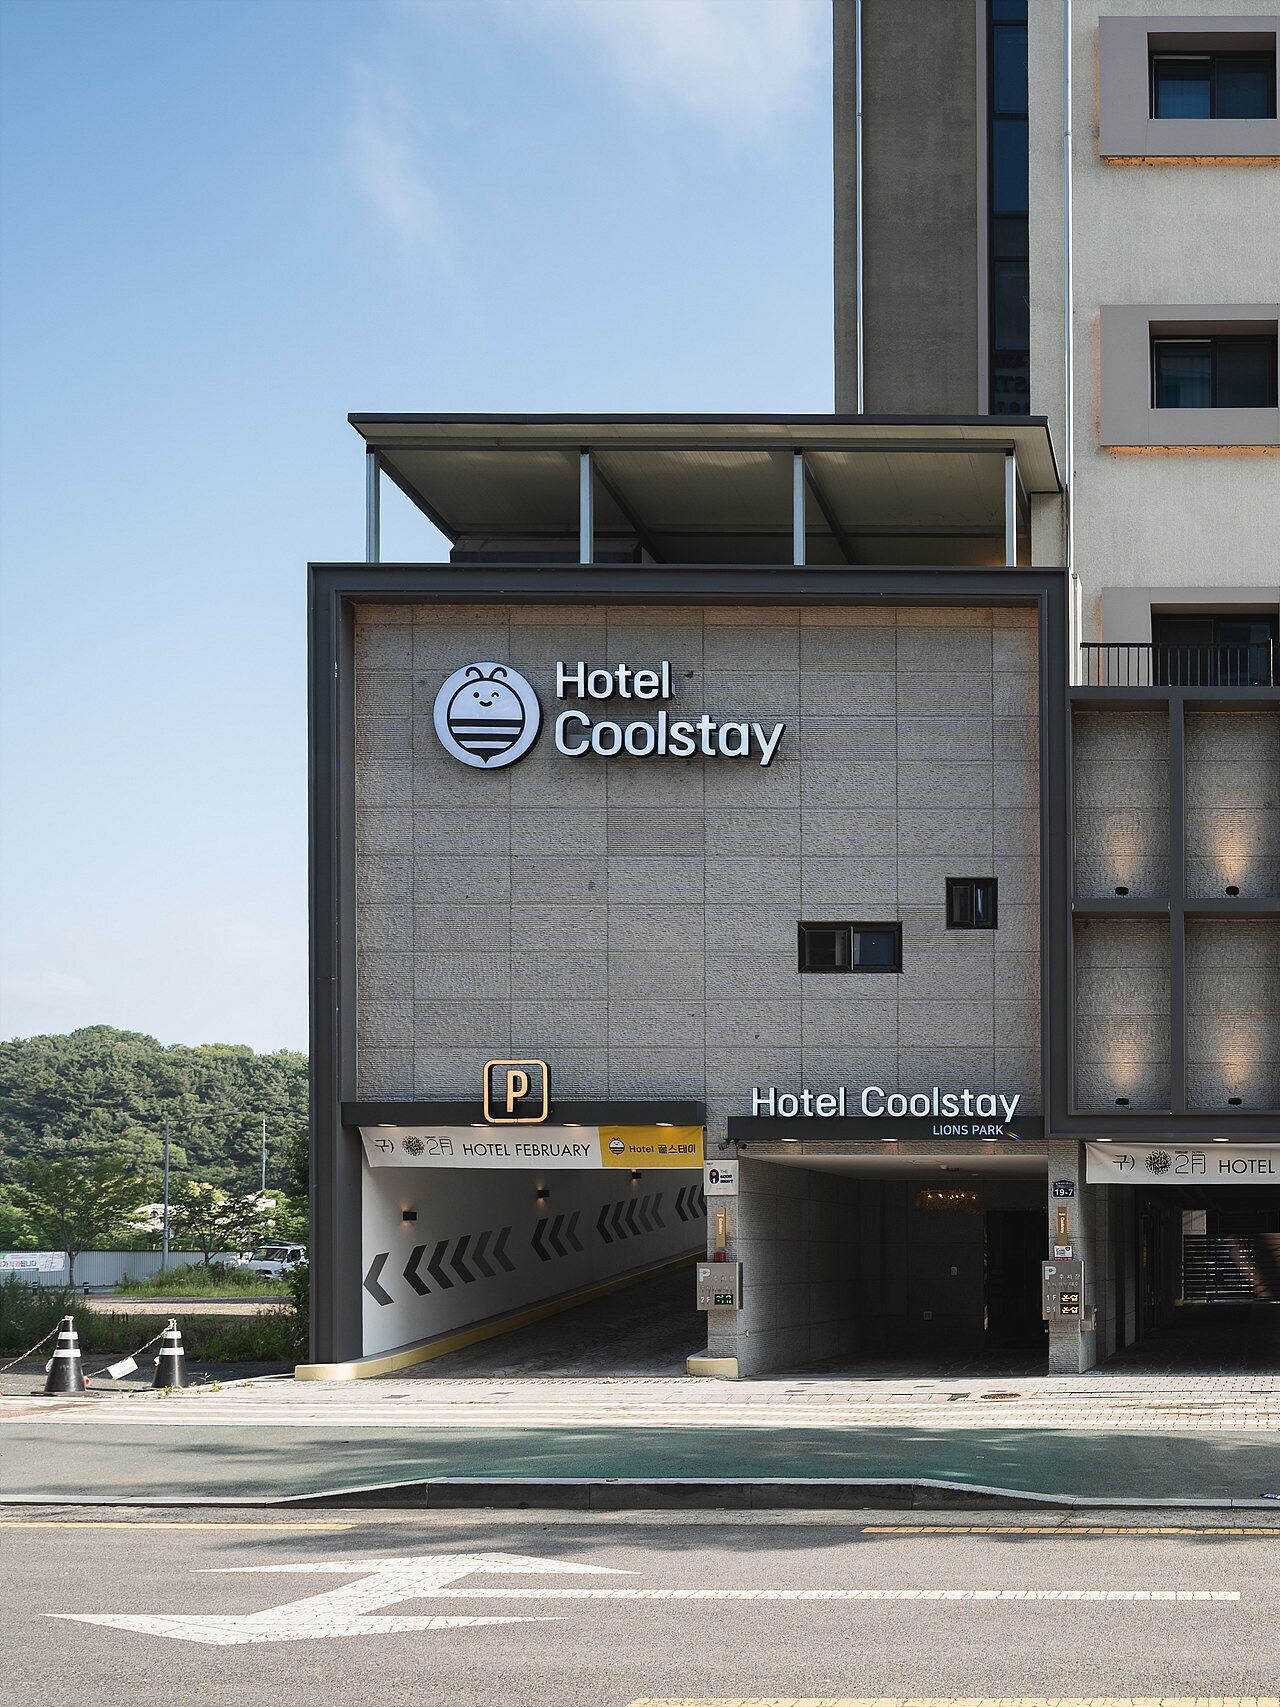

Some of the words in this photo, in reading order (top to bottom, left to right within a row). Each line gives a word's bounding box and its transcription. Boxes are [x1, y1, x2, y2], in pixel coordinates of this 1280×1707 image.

[556, 661, 671, 700] Hotel
[555, 710, 785, 767] Coolstay
[506, 1070, 531, 1113] P
[752, 1086, 846, 1118] Hotel
[861, 1086, 1021, 1123] Coolstay
[933, 1125, 969, 1136] LIONS
[972, 1125, 1004, 1136] PARK
[374, 1139, 394, 1153] 구)
[463, 1143, 511, 1157] HOTEL
[515, 1143, 591, 1157] FEBRUARY
[629, 1145, 654, 1153] Hotel
[657, 1144, 696, 1154] 꿀스테이
[1112, 1154, 1135, 1170] 구)
[1218, 1159, 1276, 1175] HOTEL
[1055, 1188, 1074, 1196] 19-7
[699, 1268, 711, 1282] P
[1044, 1266, 1057, 1280] P
